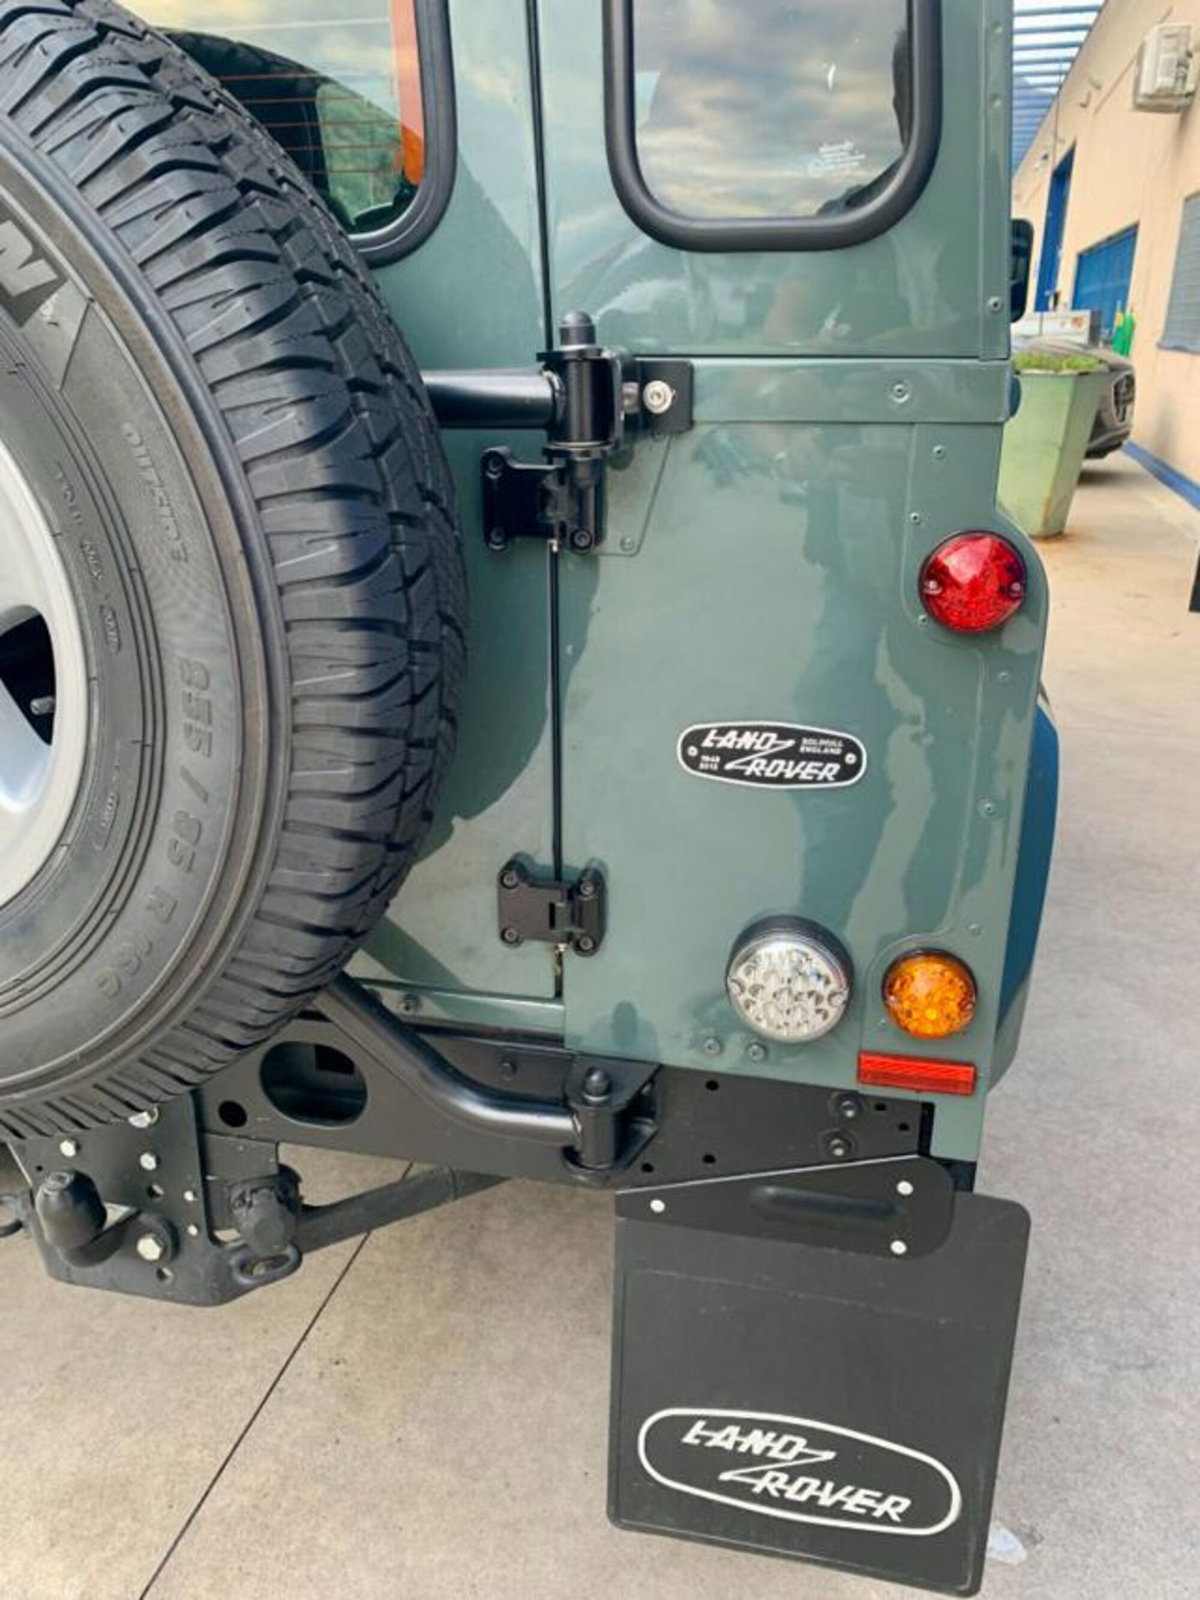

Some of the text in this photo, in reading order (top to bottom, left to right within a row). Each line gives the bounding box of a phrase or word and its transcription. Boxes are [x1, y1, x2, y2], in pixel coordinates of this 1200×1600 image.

[701, 729, 780, 751] LAND
[744, 758, 841, 781] ROVER
[681, 1419, 807, 1461] LAND
[752, 1470, 911, 1522] ROVER
